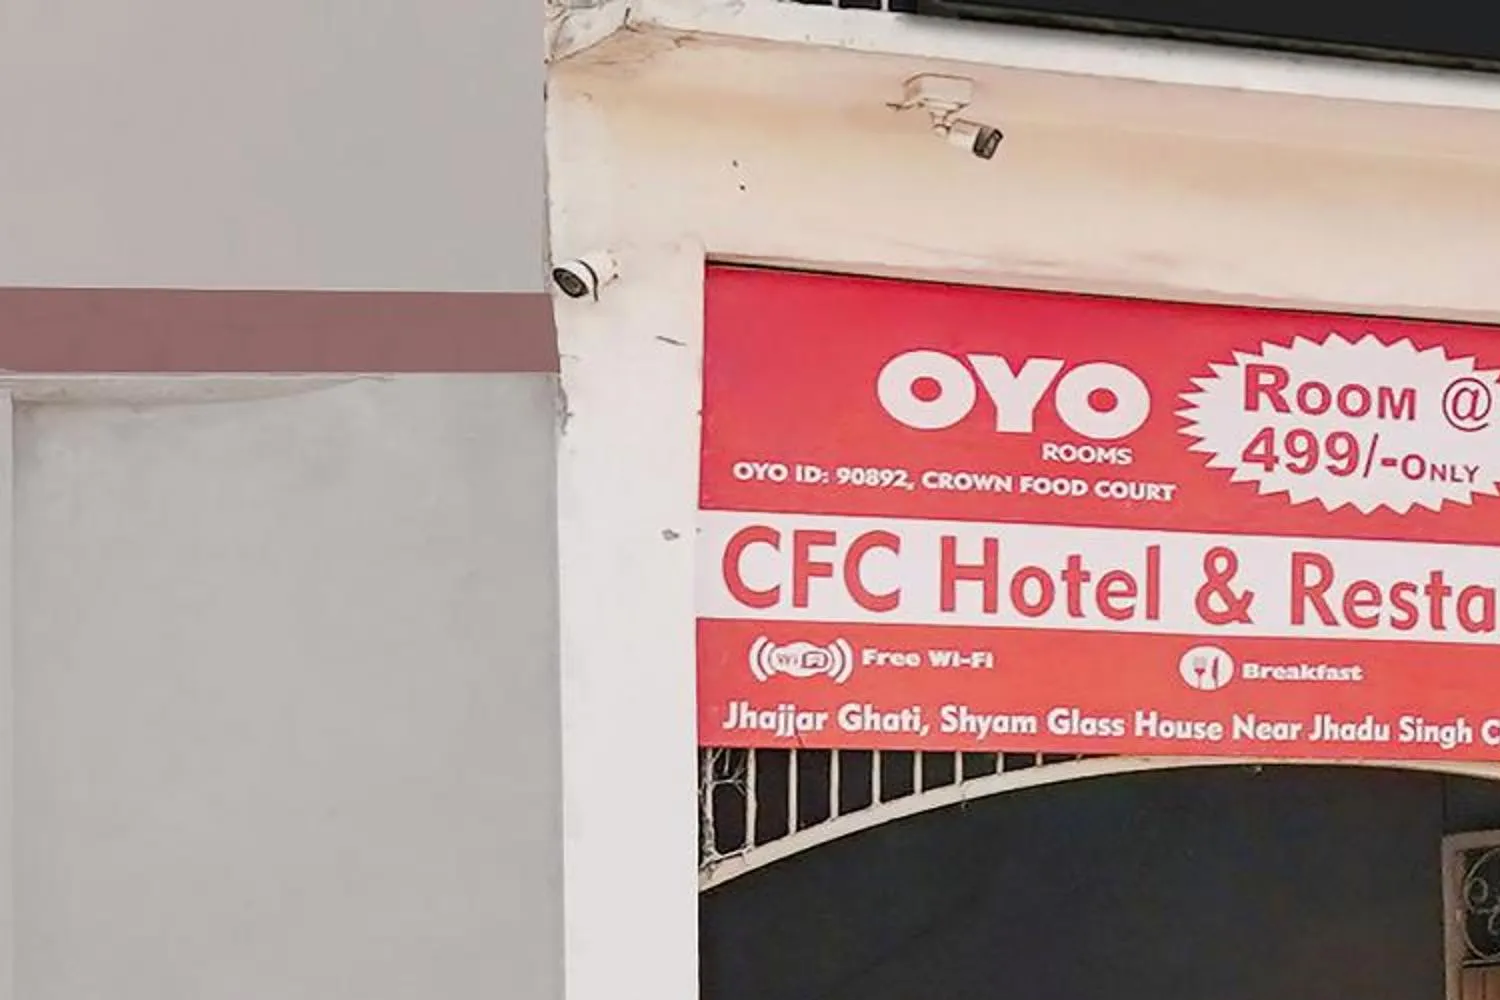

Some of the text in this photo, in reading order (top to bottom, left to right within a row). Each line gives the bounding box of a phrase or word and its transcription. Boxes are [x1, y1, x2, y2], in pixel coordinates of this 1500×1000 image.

[875, 348, 1152, 440] OYO
[1441, 376, 1493, 434] @
[1041, 441, 1134, 466] ROOMS
[731, 461, 1177, 502] OYO ID: 90892, CROWN FOOD COURT
[721, 525, 902, 612] CFC
[938, 534, 1161, 622] Hotel
[1194, 545, 1256, 626] &
[862, 648, 922, 669] Free
[1241, 660, 1365, 682] Breakfast
[722, 699, 829, 738] Jhajjar
[837, 702, 931, 737] Ghati,
[940, 706, 1038, 741] Shyam
[1046, 708, 1125, 738] Glass
[1133, 711, 1222, 742] House
[1231, 714, 1303, 743] Near
[1307, 714, 1392, 745] Jhadu
[1398, 716, 1474, 751] Singh
